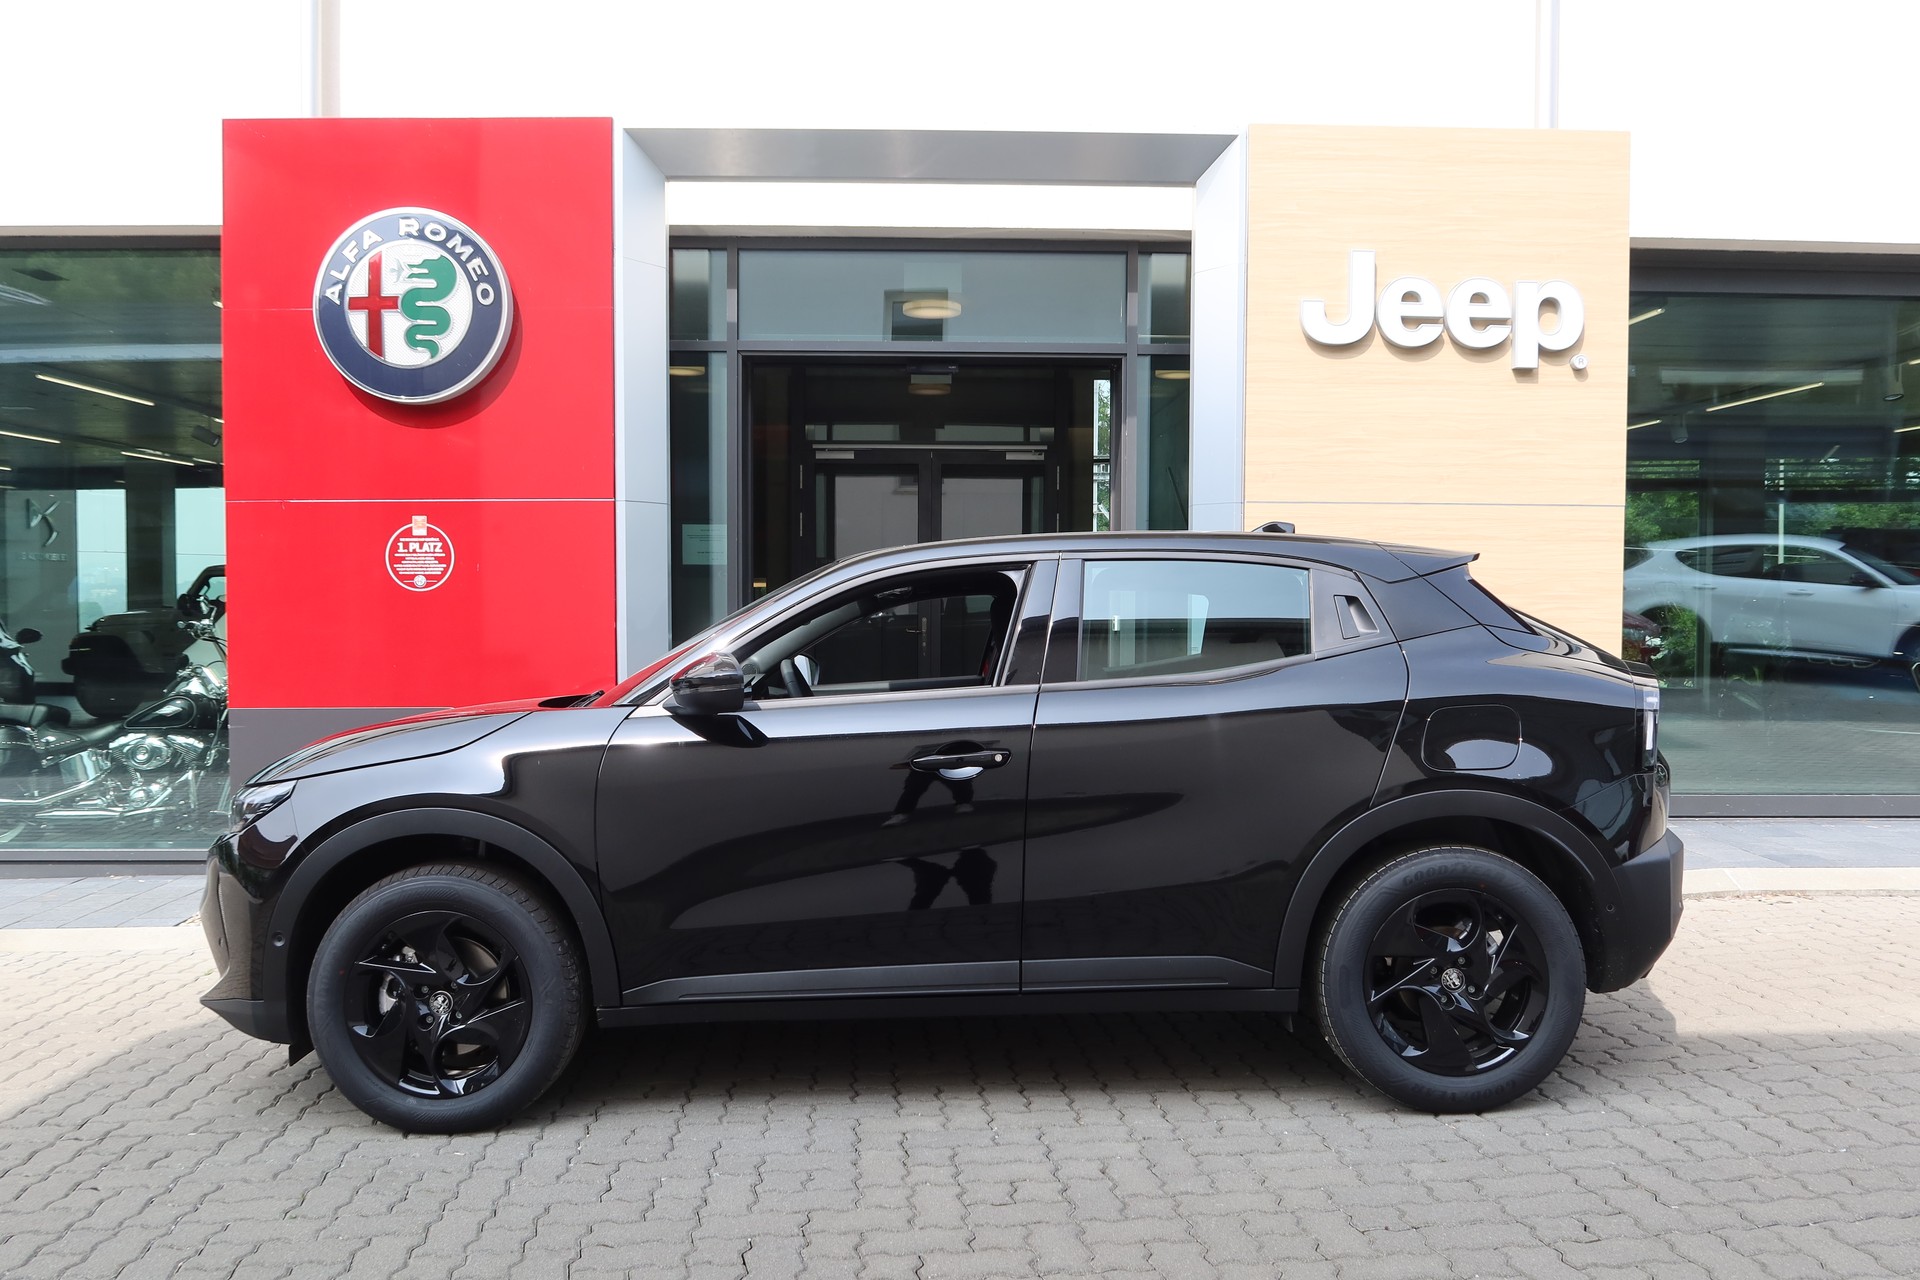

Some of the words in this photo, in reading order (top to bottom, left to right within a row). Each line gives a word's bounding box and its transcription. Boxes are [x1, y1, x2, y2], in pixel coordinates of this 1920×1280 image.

[325, 229, 383, 306] ALFA
[398, 217, 495, 306] ROMEO
[397, 542, 408, 553] 1.
[408, 542, 443, 553] PLATZ
